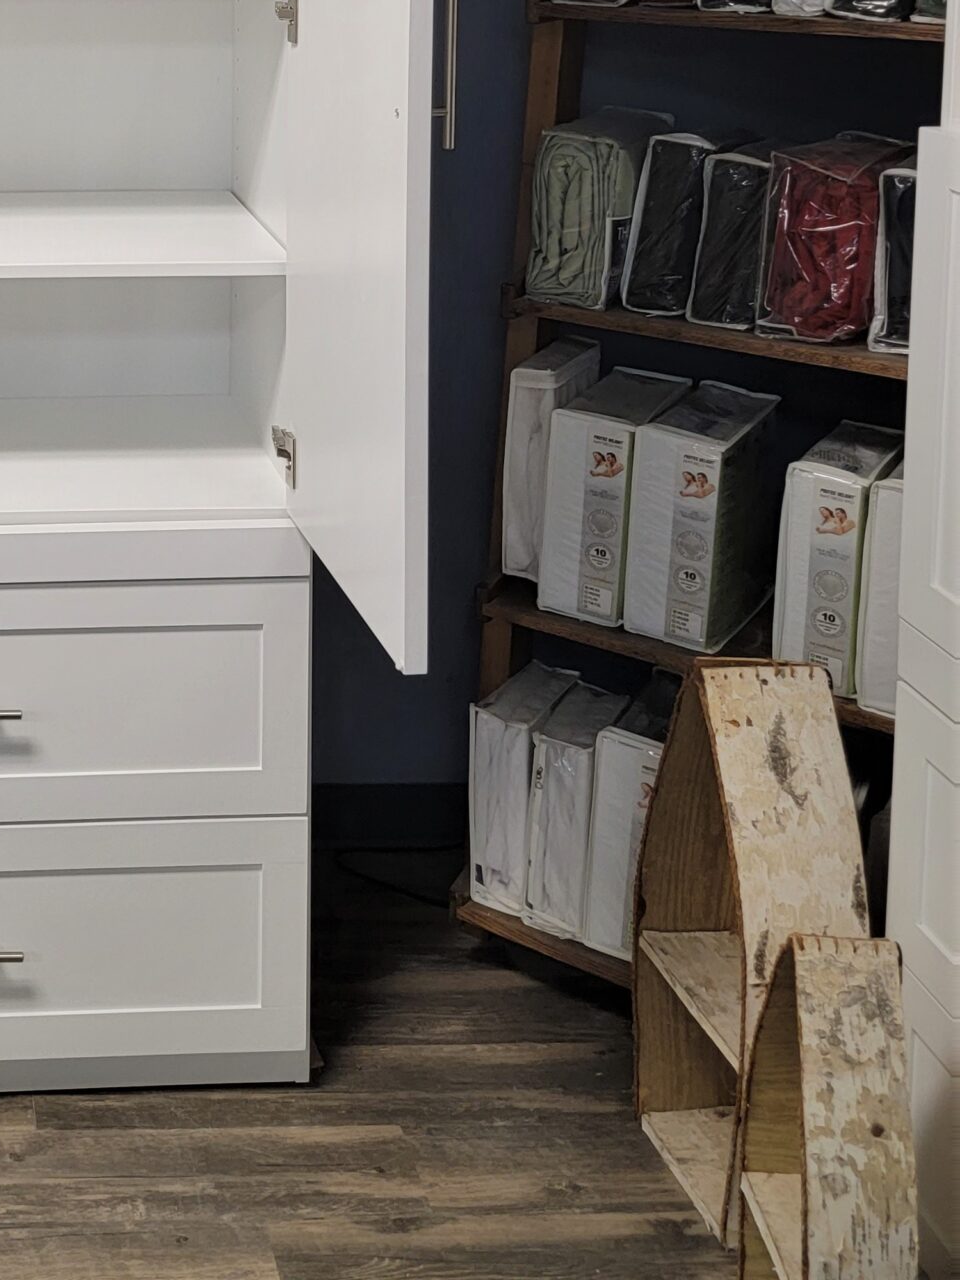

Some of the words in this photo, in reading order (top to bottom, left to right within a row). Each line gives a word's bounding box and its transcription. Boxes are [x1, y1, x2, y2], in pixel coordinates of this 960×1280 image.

[594, 547, 607, 557] 10
[683, 570, 697, 581] 10
[821, 612, 836, 623] 10
